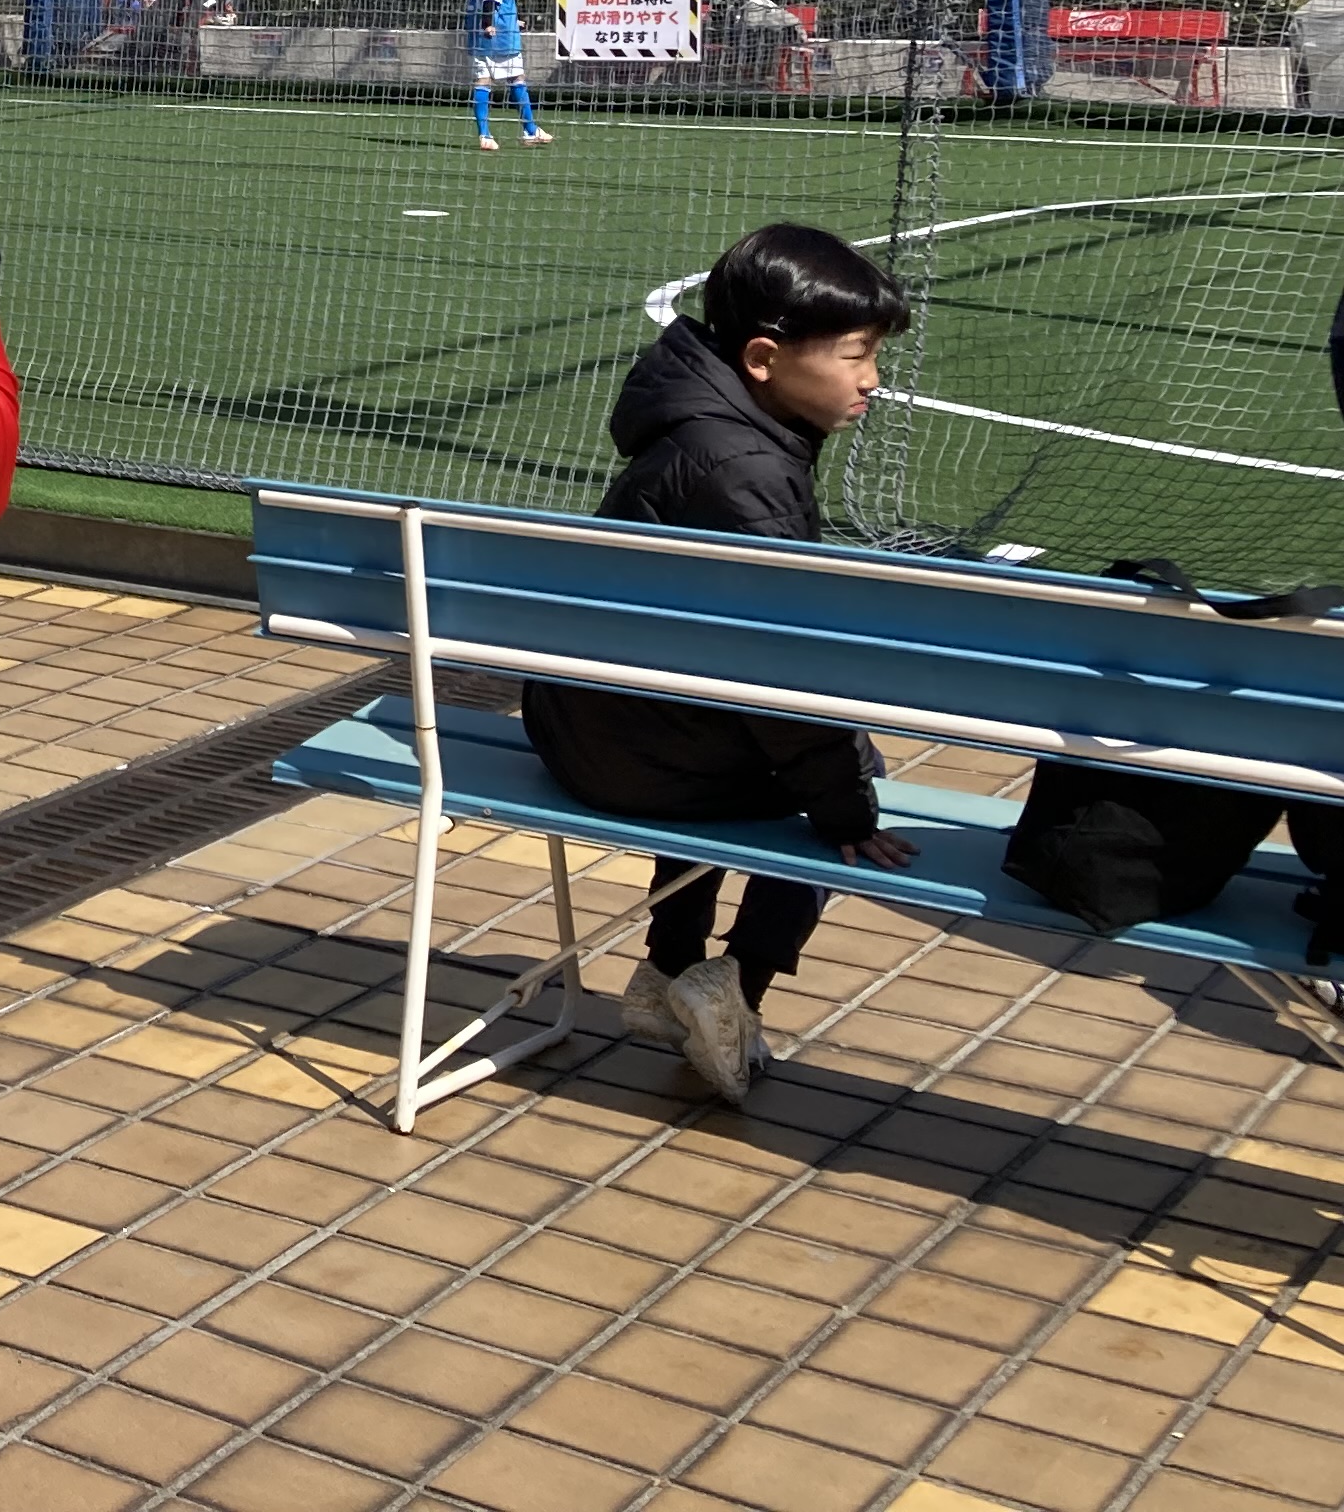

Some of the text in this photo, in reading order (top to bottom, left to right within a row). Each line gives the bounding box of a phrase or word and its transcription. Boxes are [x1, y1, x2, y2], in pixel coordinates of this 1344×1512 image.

[576, 11, 680, 25] 床が滑りやすく
[595, 31, 659, 44] なります！
